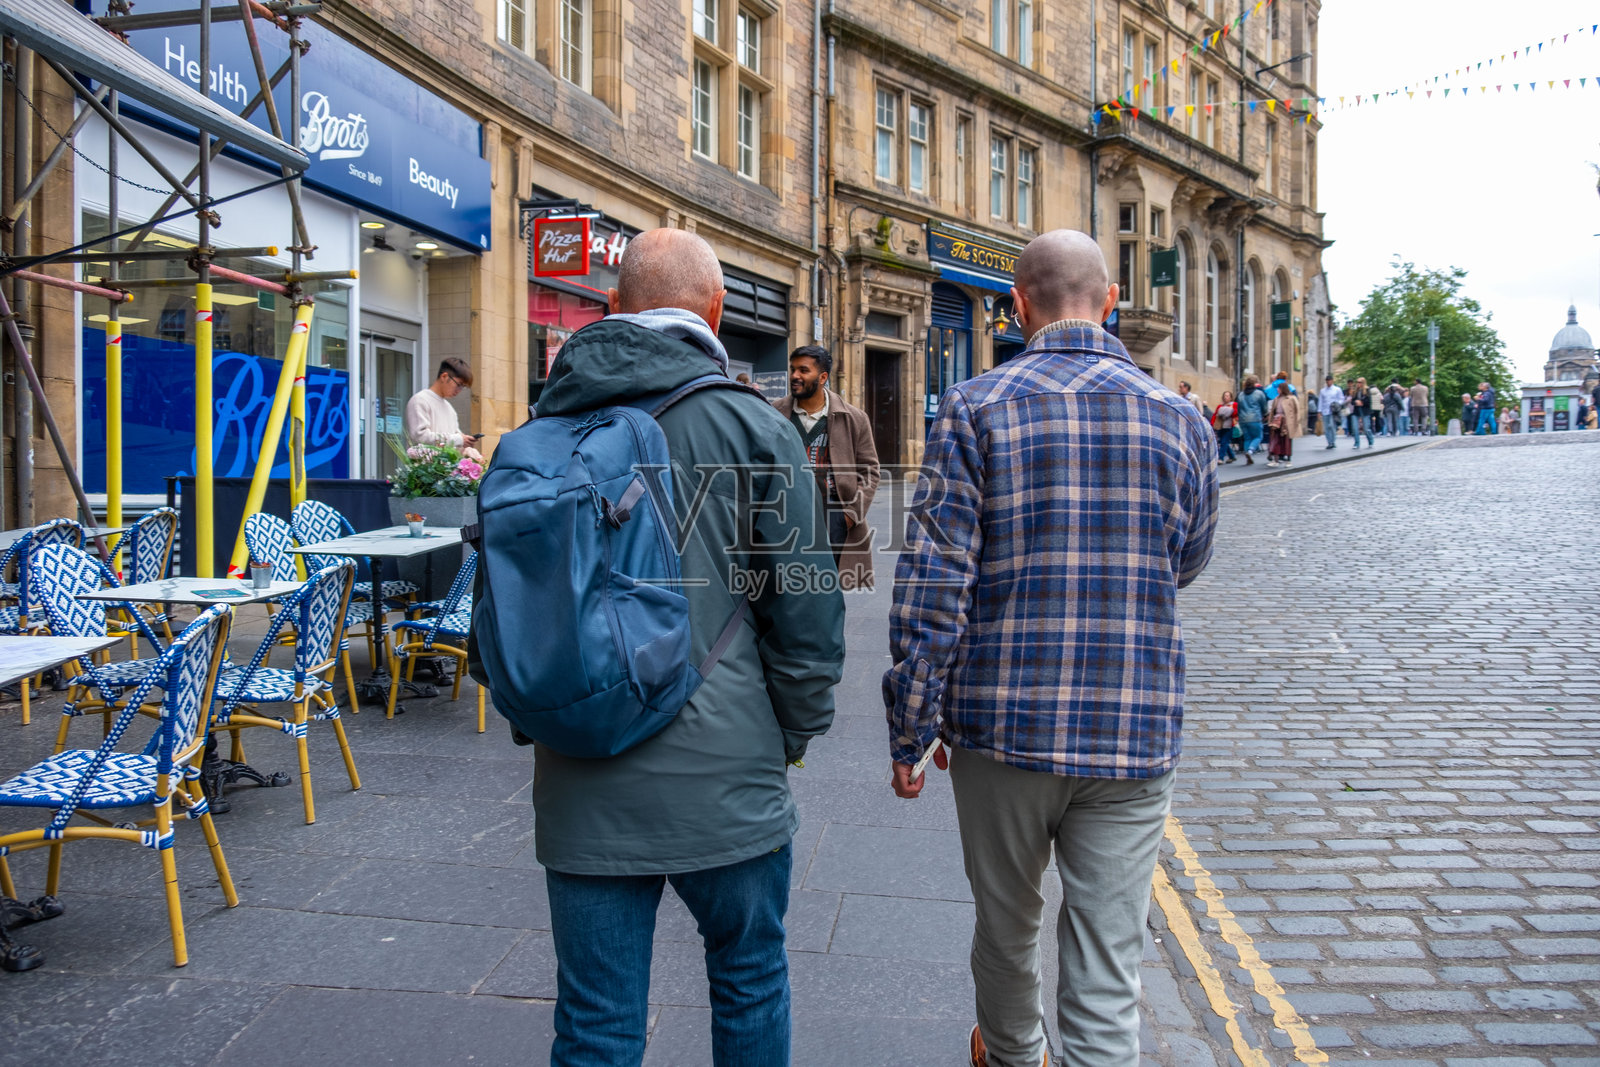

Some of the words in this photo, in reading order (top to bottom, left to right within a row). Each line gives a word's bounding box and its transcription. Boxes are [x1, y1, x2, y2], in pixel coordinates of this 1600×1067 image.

[300, 91, 369, 161] Boots
[348, 163, 367, 181] Since
[409, 157, 459, 209] Beauty
[539, 229, 582, 248] Pizza
[543, 247, 577, 264] Hut
[950, 241, 970, 261] The
